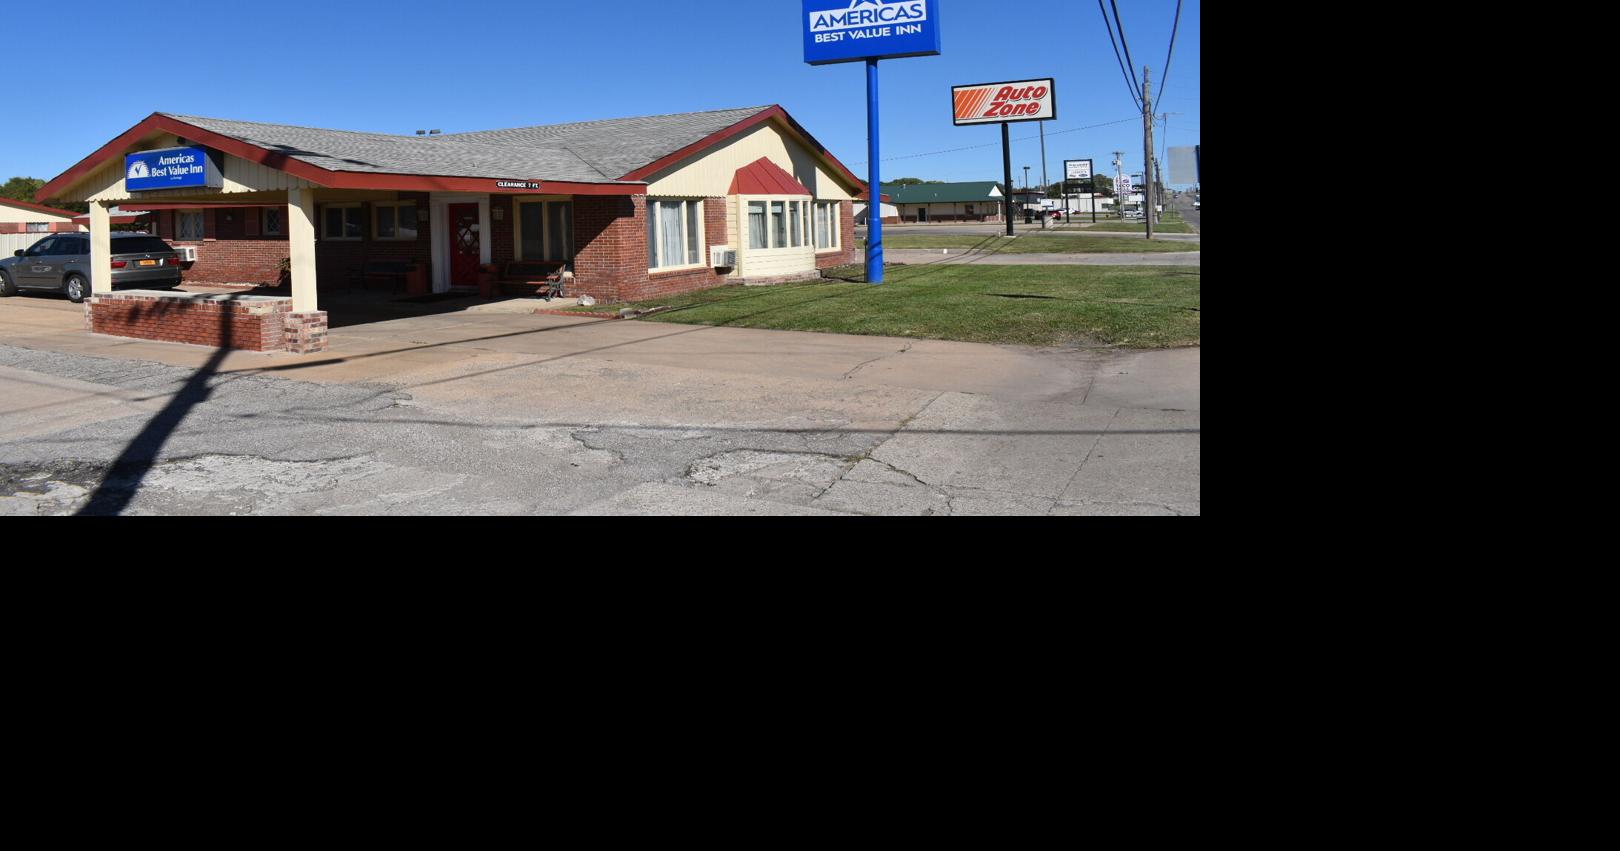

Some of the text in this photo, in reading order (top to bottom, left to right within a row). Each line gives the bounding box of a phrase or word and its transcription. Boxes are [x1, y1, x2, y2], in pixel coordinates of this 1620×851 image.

[814, 4, 923, 29] AMERICAS
[814, 24, 922, 43] BEST VALUE INN
[994, 86, 1047, 102] Auto
[983, 101, 1041, 118] Zone
[158, 153, 194, 165] Americas
[151, 164, 203, 177] Best Value Inn
